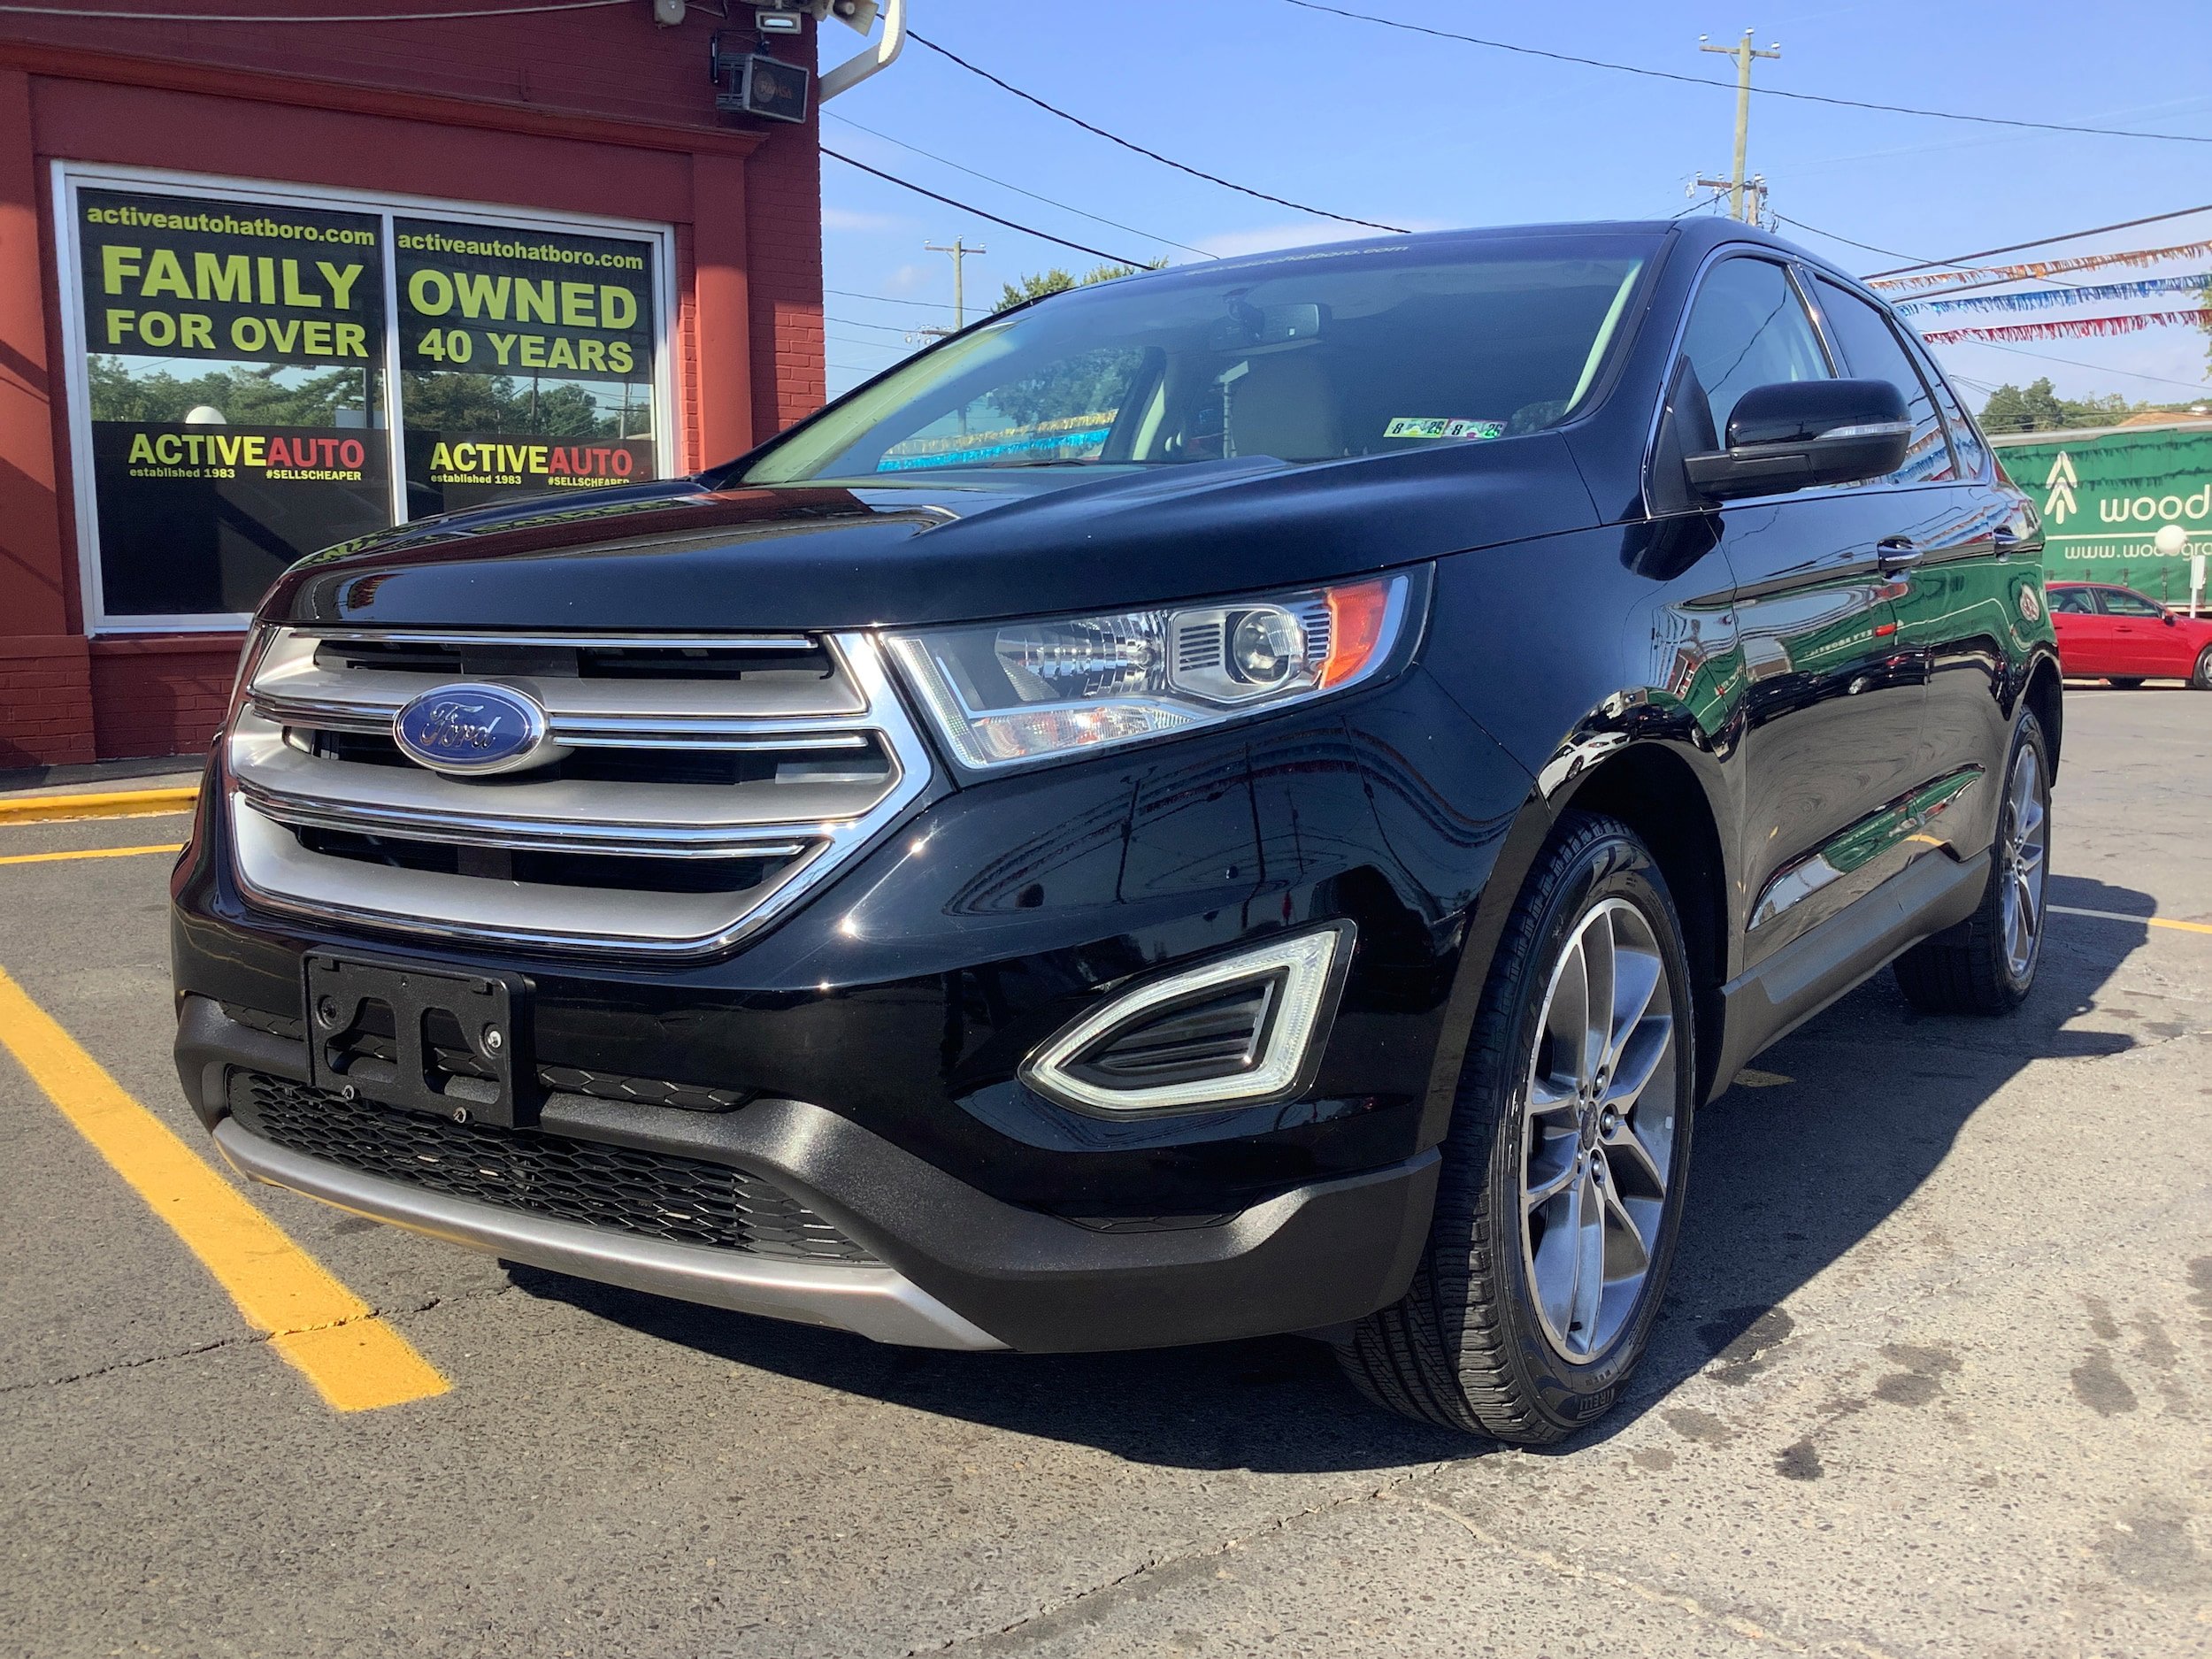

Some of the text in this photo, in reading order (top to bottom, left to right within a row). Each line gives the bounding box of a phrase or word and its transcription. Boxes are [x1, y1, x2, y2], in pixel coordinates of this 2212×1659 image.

[87, 207, 375, 246] activeautohatboro.com
[397, 233, 643, 270] activeautohatboro.com
[102, 245, 365, 310] FAMILY
[408, 269, 638, 330] OWNED
[106, 309, 369, 358] FOR OVER
[418, 328, 634, 373] 40 YEARS
[1392, 423, 1405, 434] 8
[1451, 424, 1463, 435] 8
[129, 467, 236, 479] established 1983
[265, 469, 362, 481] #SELLSCHEAPER
[430, 473, 522, 485] established 1983
[2100, 484, 2210, 523] wood
[419, 701, 502, 749] Ford
